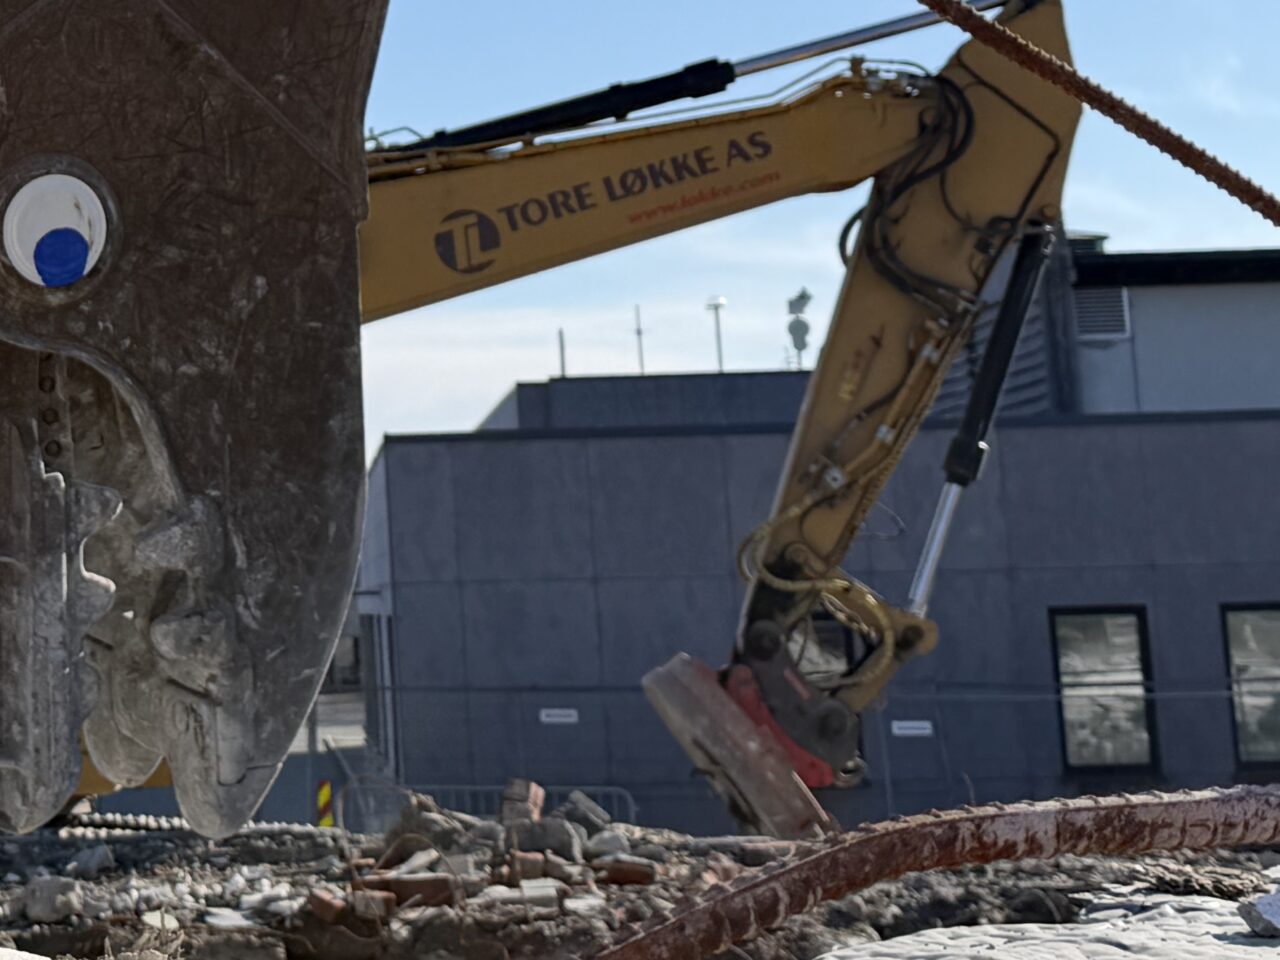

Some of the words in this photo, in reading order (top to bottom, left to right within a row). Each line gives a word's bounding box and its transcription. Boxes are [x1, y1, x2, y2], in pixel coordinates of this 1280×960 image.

[499, 181, 597, 232] TORE
[604, 145, 720, 202] LØKKE
[725, 131, 774, 168] AS
